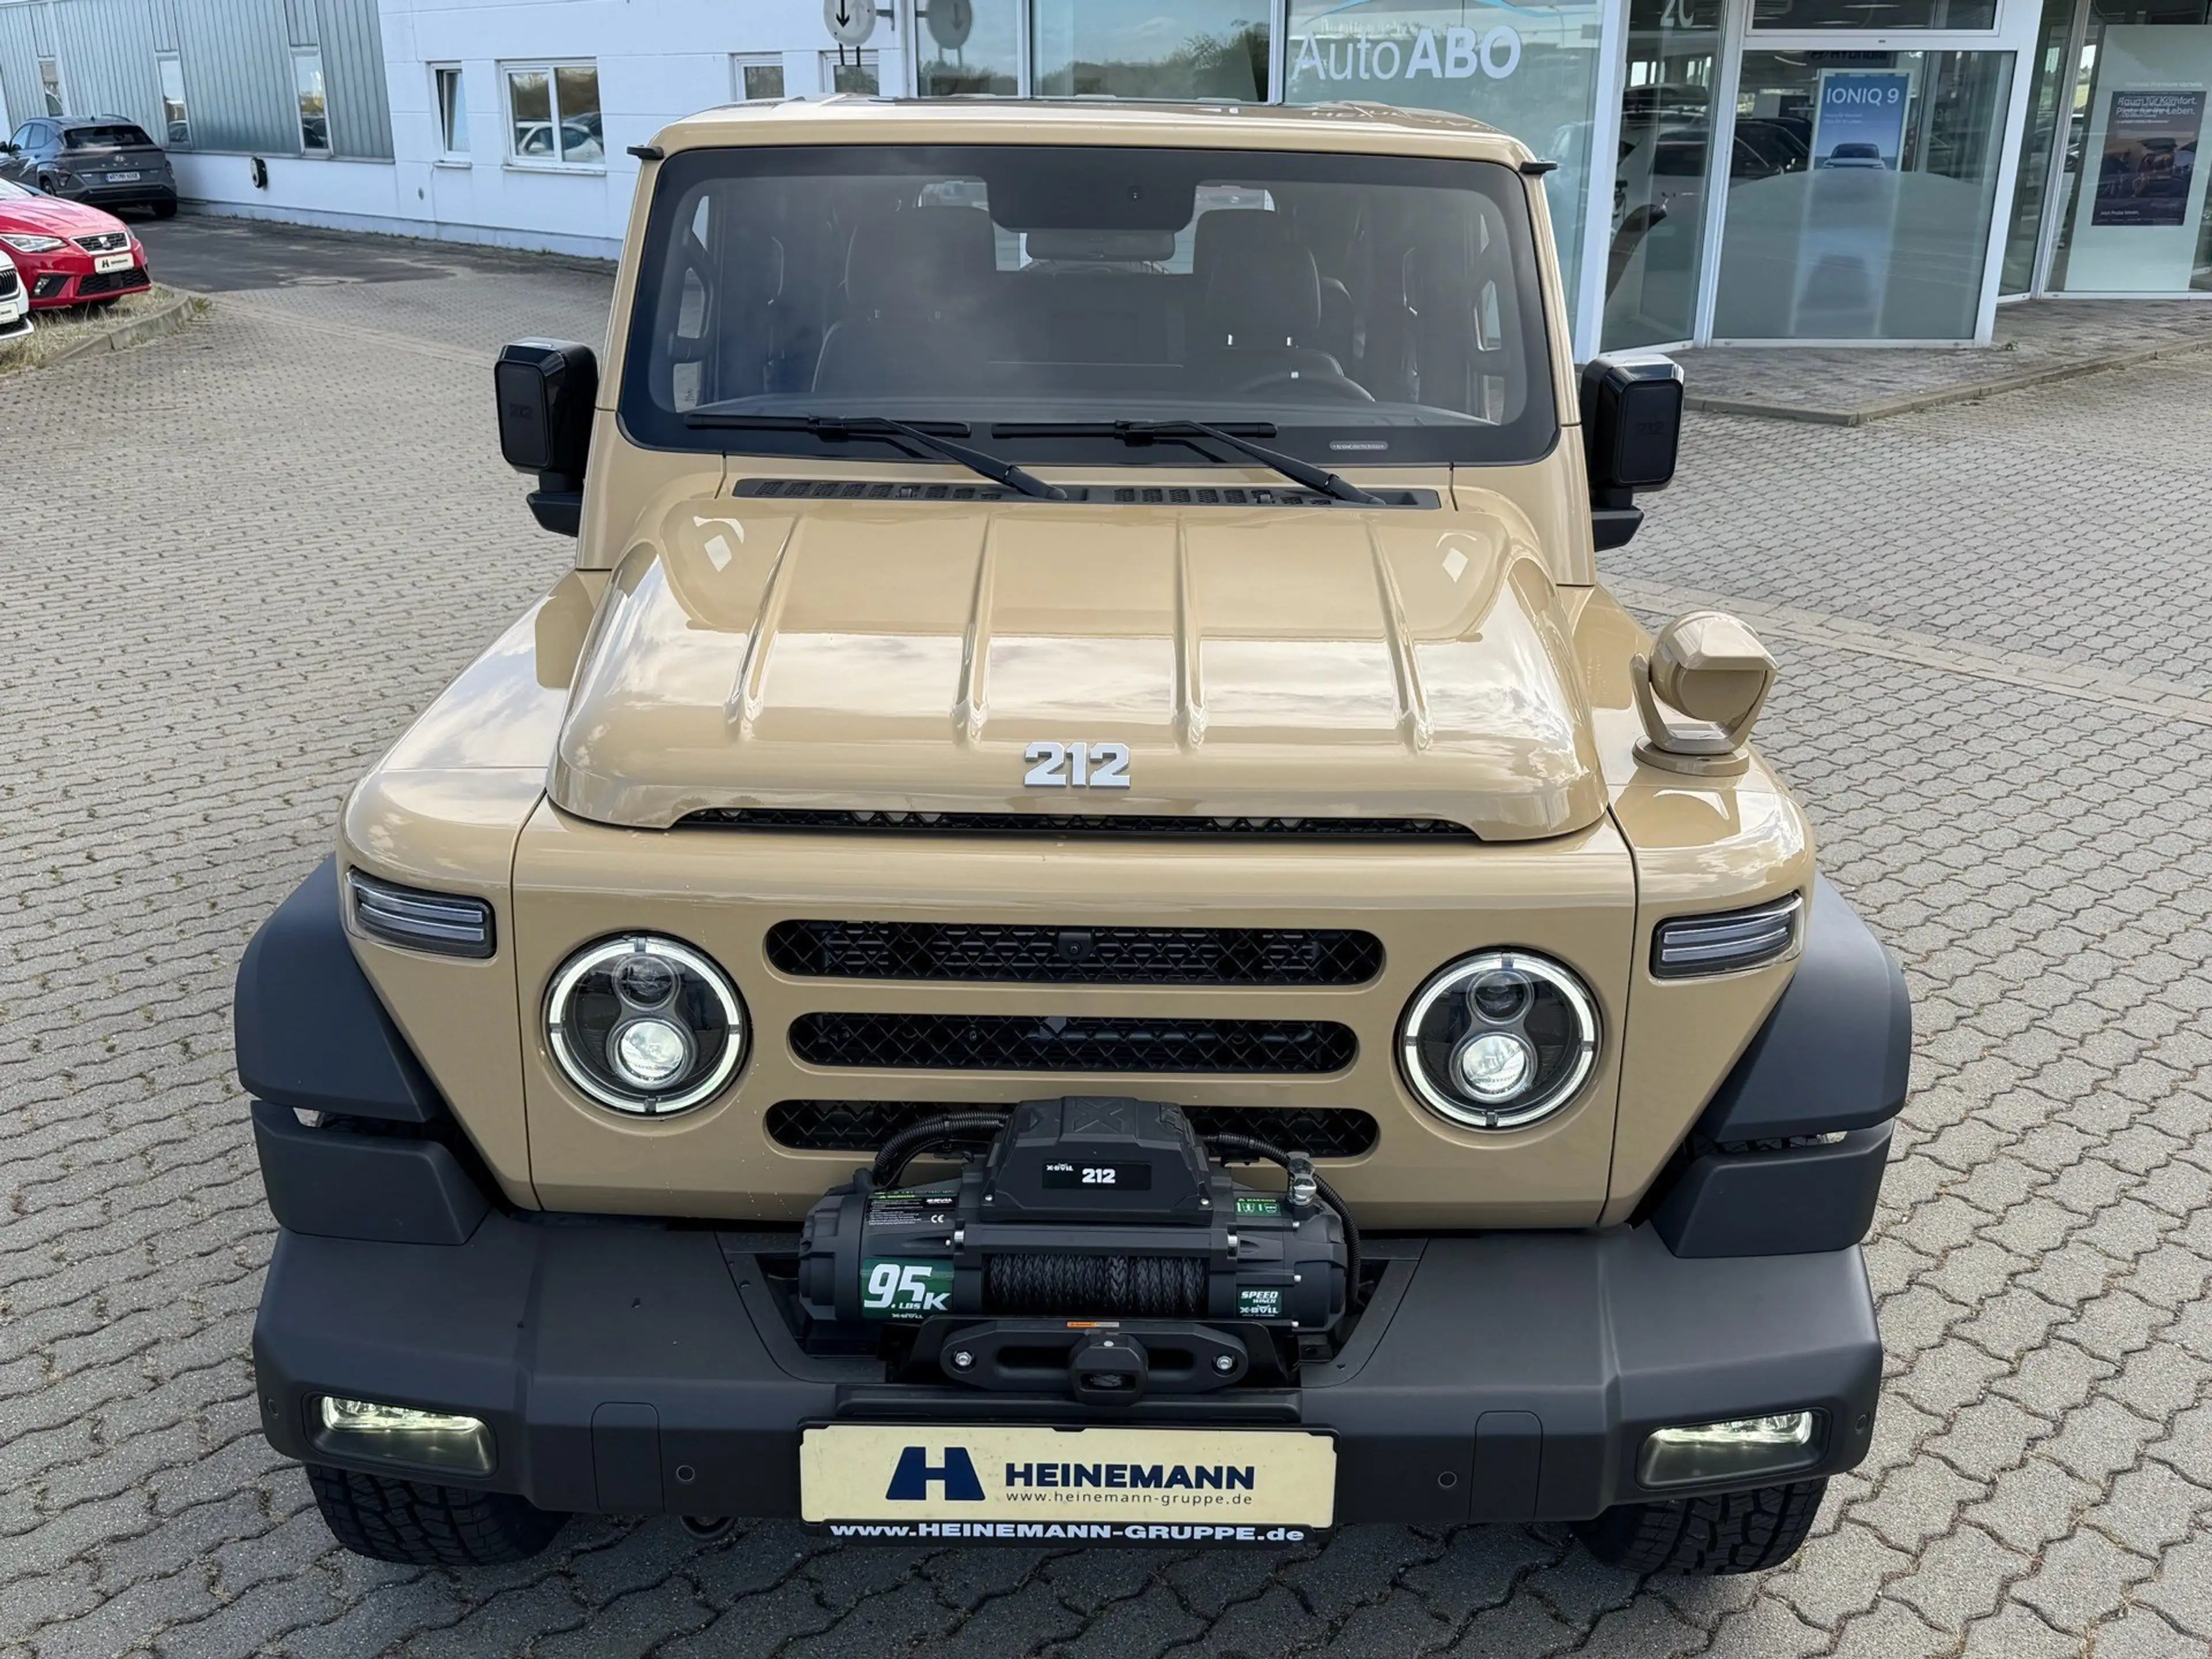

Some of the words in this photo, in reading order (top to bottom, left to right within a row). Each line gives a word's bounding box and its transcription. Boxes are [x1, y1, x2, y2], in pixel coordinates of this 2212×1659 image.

[1826, 88, 1883, 107] IONIQ
[1887, 88, 1900, 104] 9
[1024, 741, 1130, 789] 212
[1082, 1168, 1116, 1184] 212
[1241, 1291, 1279, 1300] SPEED
[1005, 1463, 1255, 1490] HEINEMANN
[1006, 1491, 1253, 1507] www.heinemann-gruppe.de
[830, 1522, 1305, 1542] www.HEINEMANN-GRUPPE.de
